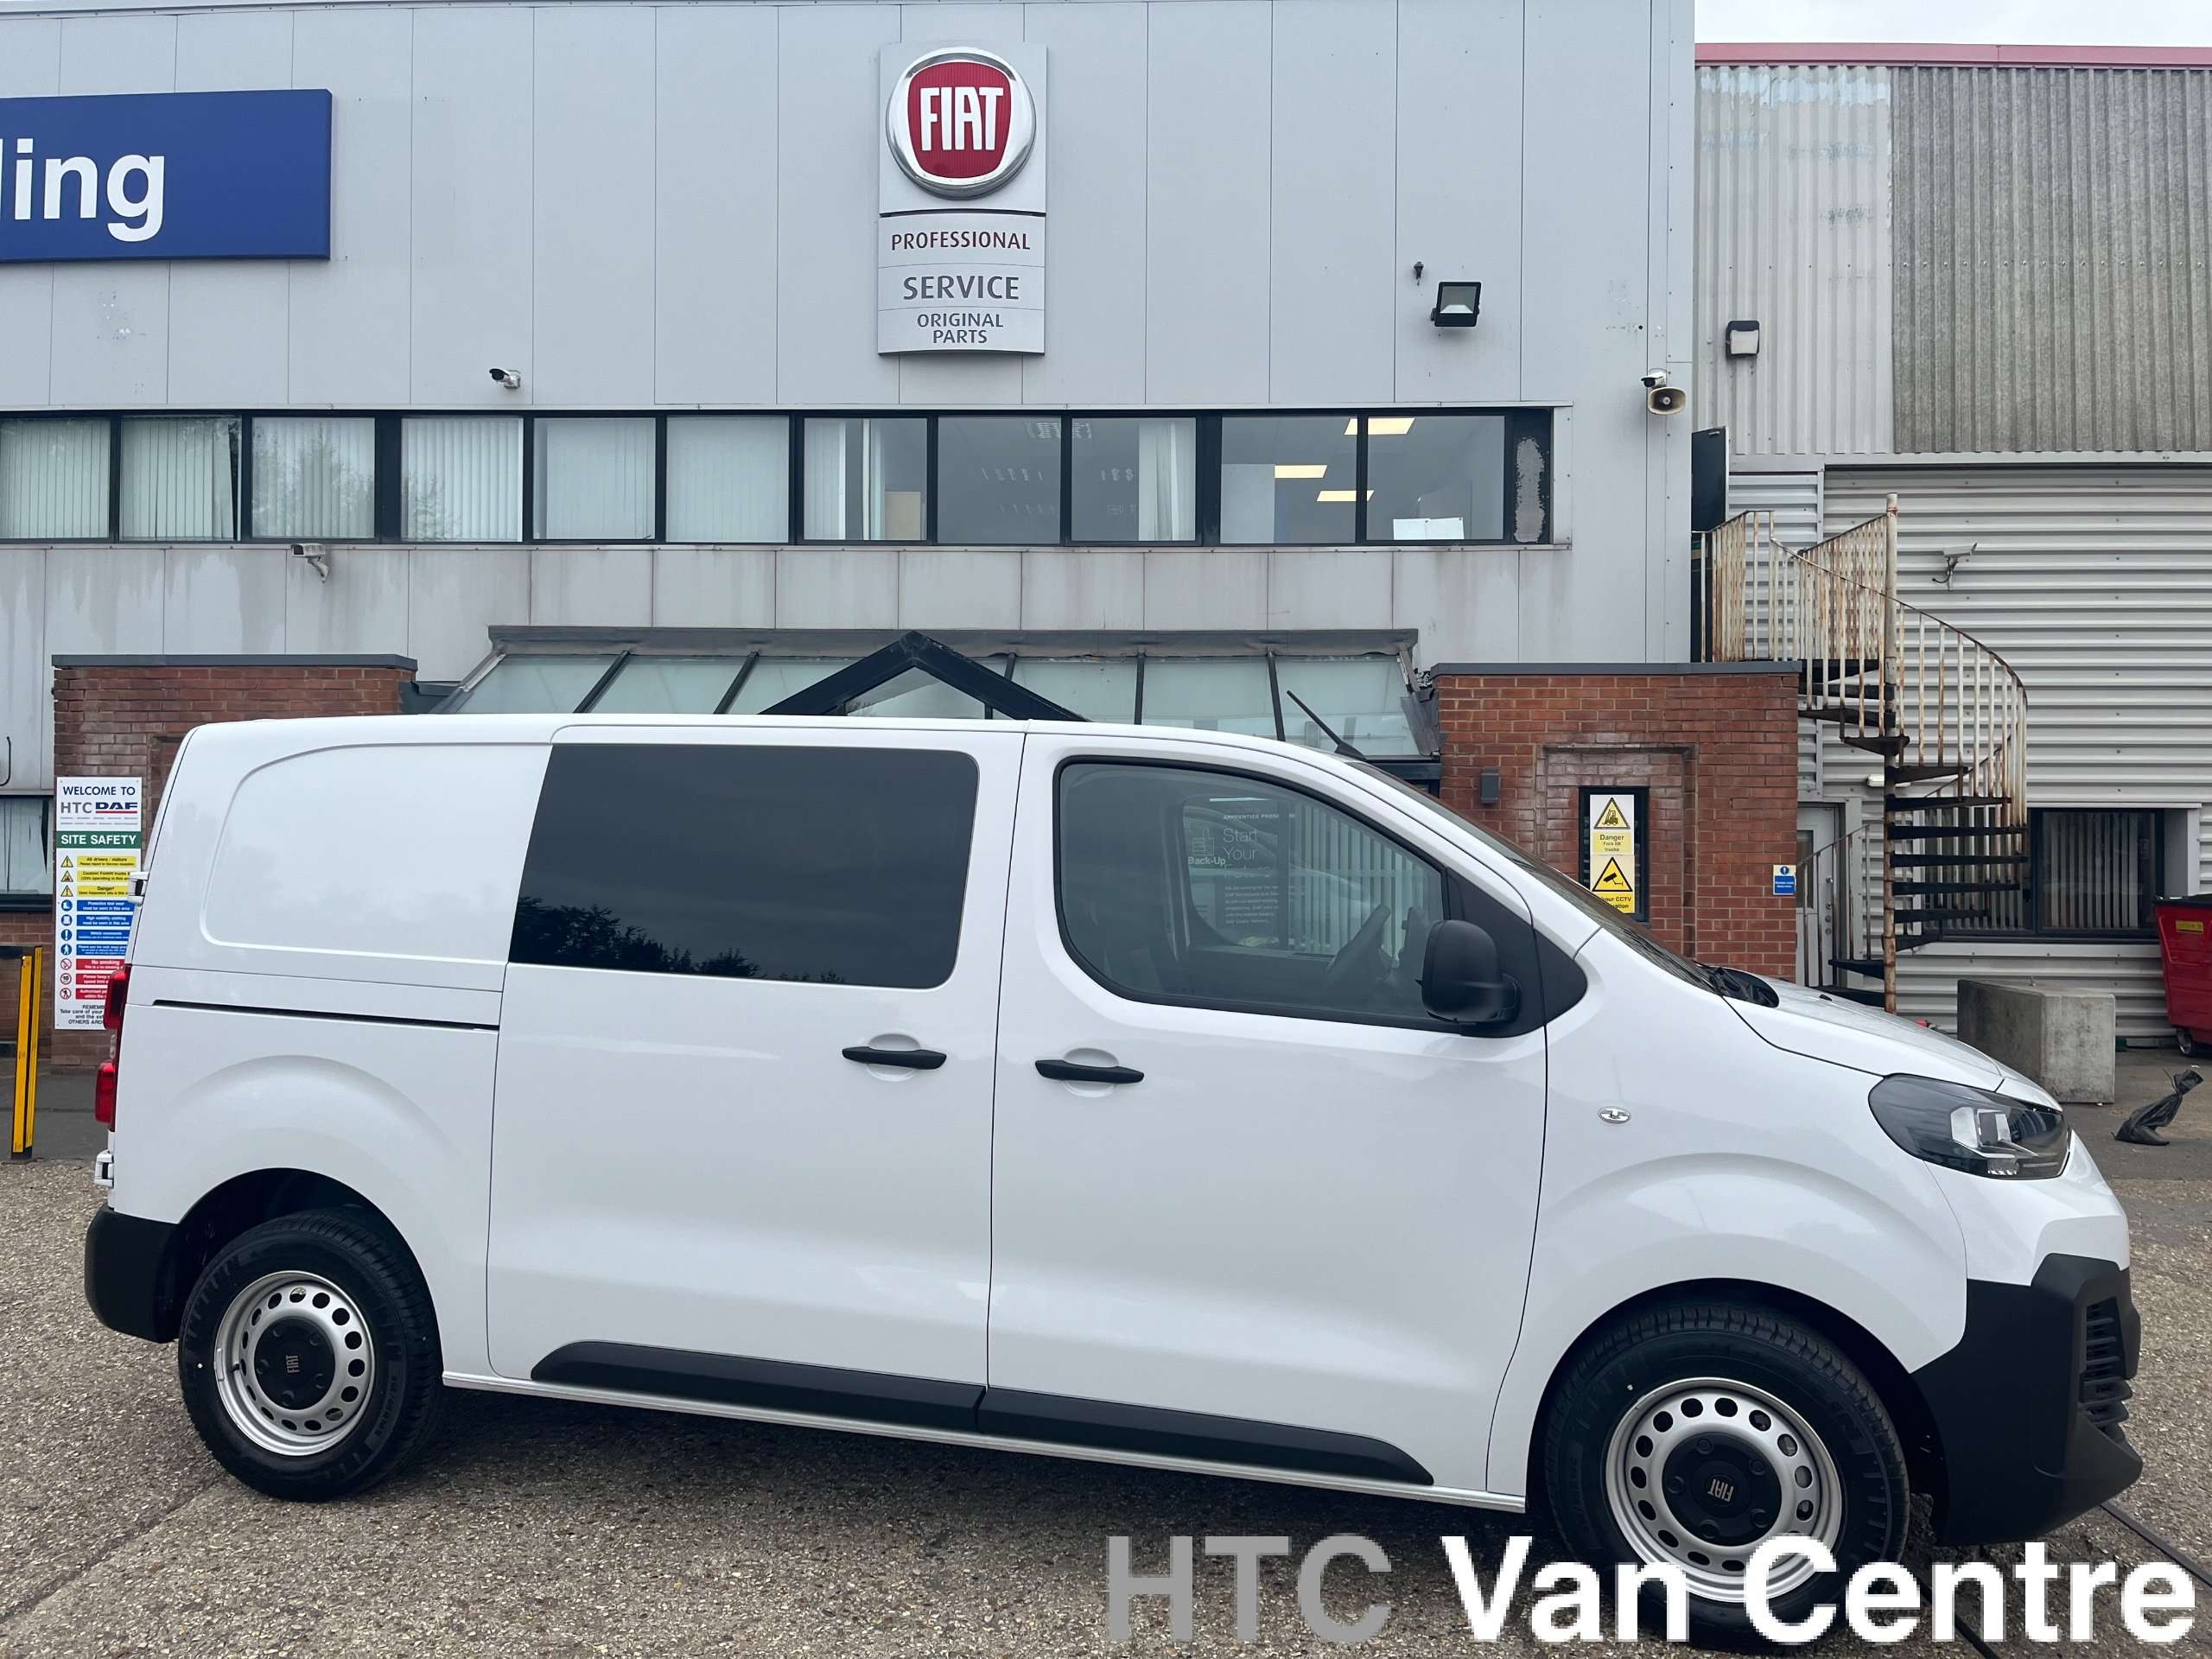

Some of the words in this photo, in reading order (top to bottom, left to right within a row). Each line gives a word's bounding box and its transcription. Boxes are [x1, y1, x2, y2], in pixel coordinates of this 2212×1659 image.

[919, 86, 1004, 151] FIAT
[0, 138, 164, 242] ing
[891, 231, 1031, 251] PROFESSIONAL
[903, 275, 1020, 301] SERVICE
[917, 313, 1004, 328] ORIGINAL
[932, 329, 988, 344] PARTS
[63, 786, 116, 796] WELCOME
[121, 786, 135, 796] TO
[60, 802, 92, 814] HTC
[60, 835, 86, 845] SITE
[90, 835, 137, 845] SAFETY
[1223, 828, 1259, 843] Start
[1223, 846, 1258, 861] Your
[1187, 856, 1226, 867] Back-Up
[286, 1354, 300, 1373] FIAT
[1707, 1478, 1734, 1502] FIAT
